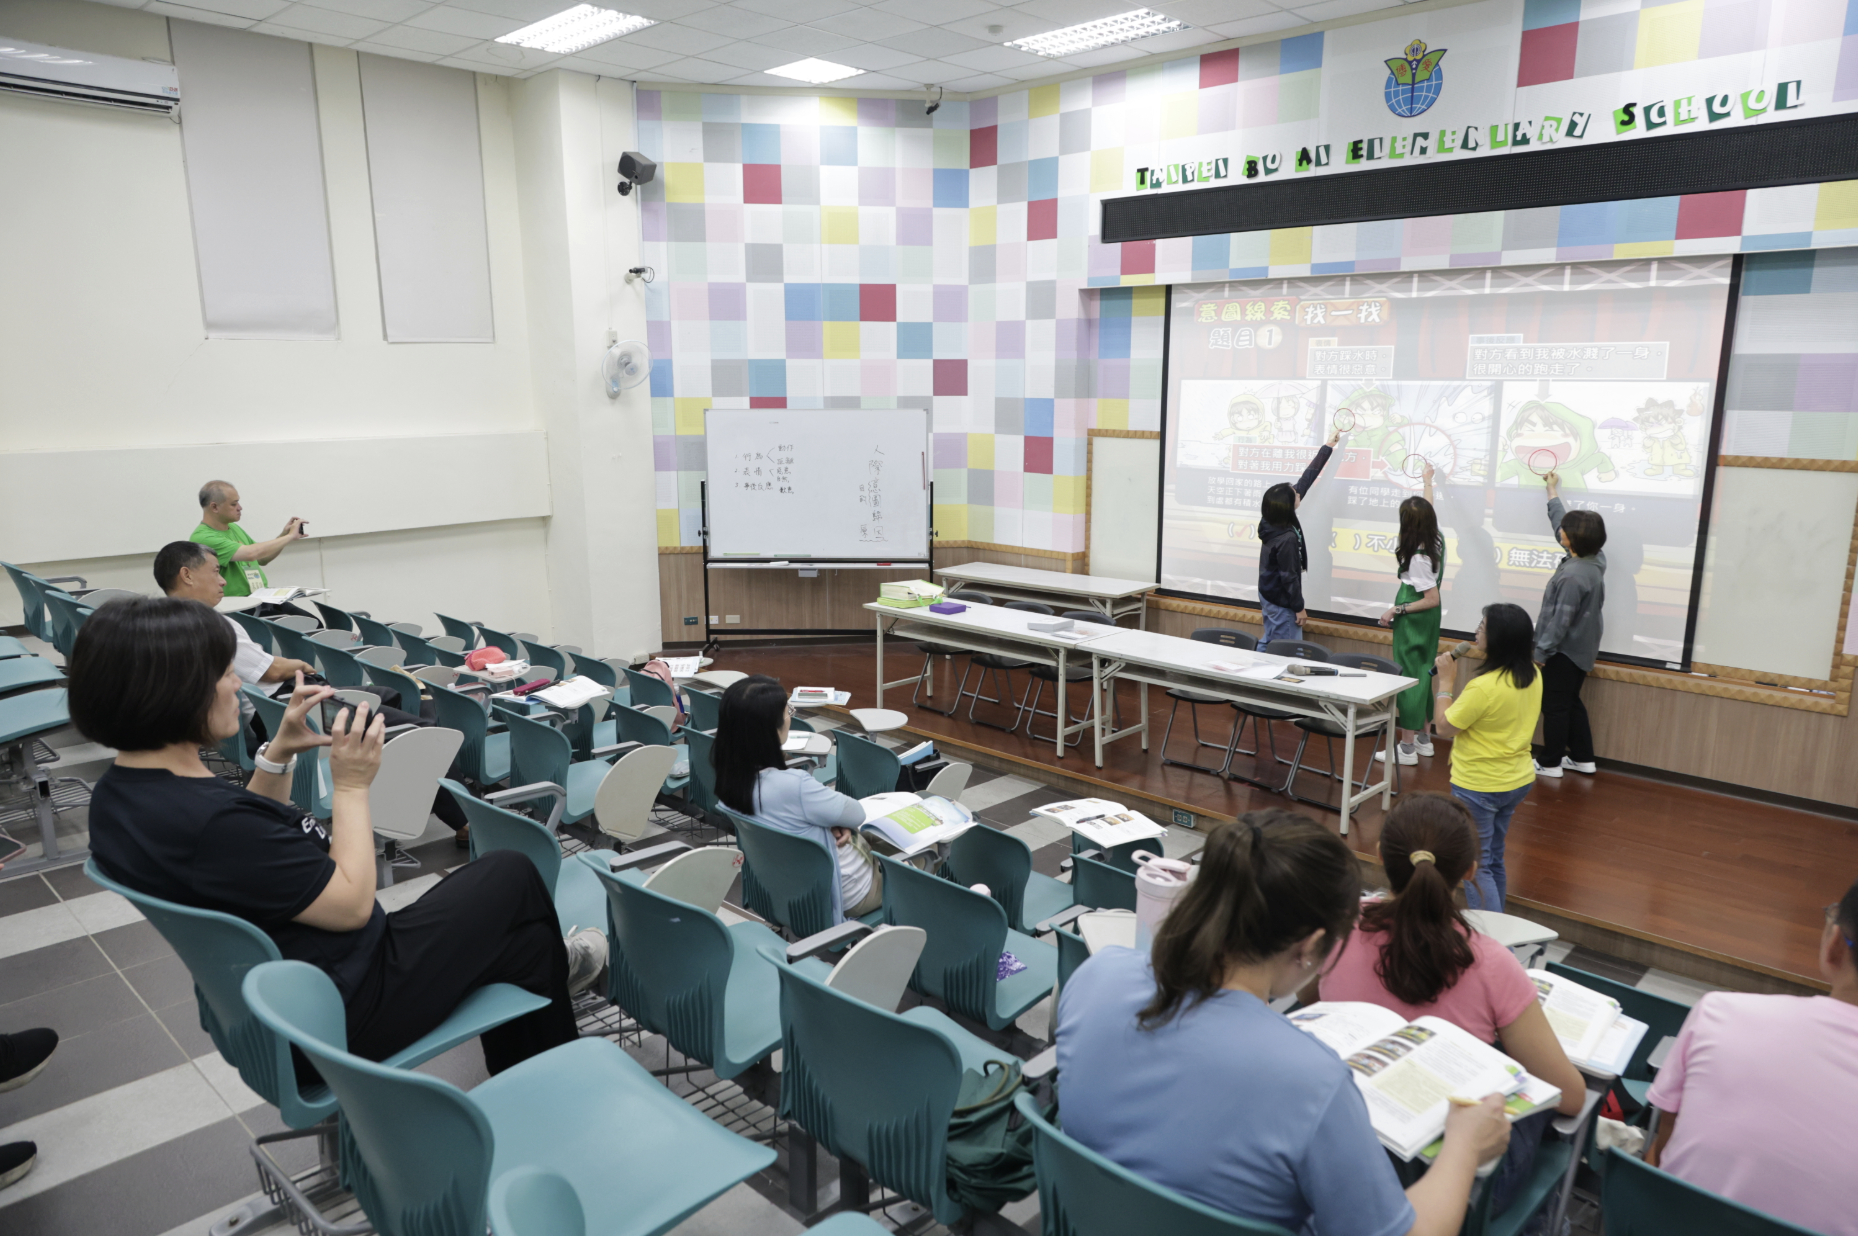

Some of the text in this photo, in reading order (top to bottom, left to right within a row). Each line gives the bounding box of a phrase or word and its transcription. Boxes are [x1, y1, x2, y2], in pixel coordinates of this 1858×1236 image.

[1137, 158, 1227, 186] TAIPEI
[1246, 150, 1282, 179] BO
[1297, 145, 1329, 168] AI
[1619, 80, 1806, 126] SCHOOL
[1197, 300, 1382, 325] 意圖線索 找一找
[1208, 327, 1255, 349] 題目
